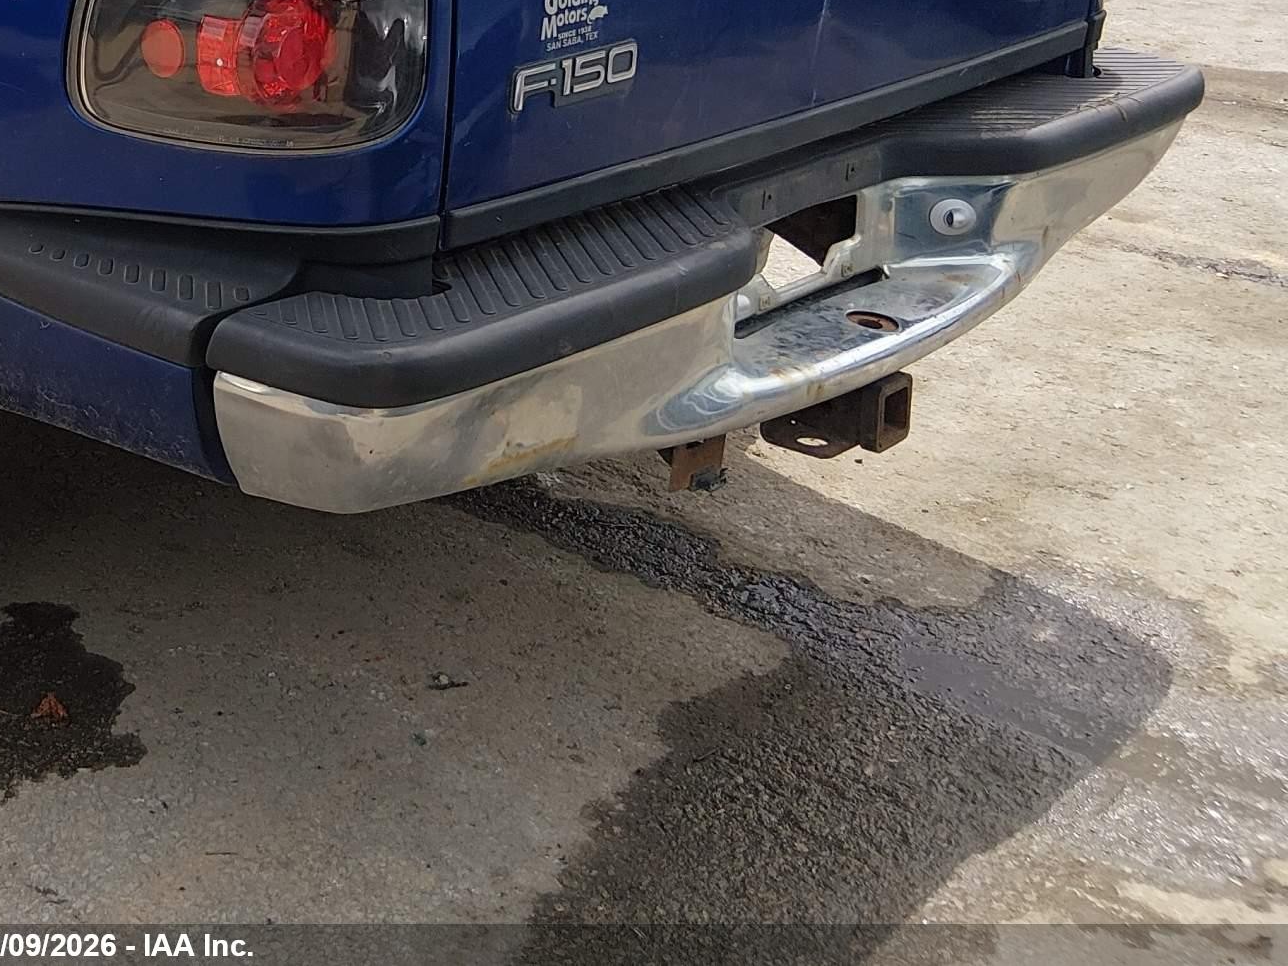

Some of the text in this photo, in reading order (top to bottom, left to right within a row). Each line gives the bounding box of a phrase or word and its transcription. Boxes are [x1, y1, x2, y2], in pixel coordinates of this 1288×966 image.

[541, 8, 587, 40] Motors
[557, 29, 576, 40] SINCE
[546, 41, 561, 52] SAN
